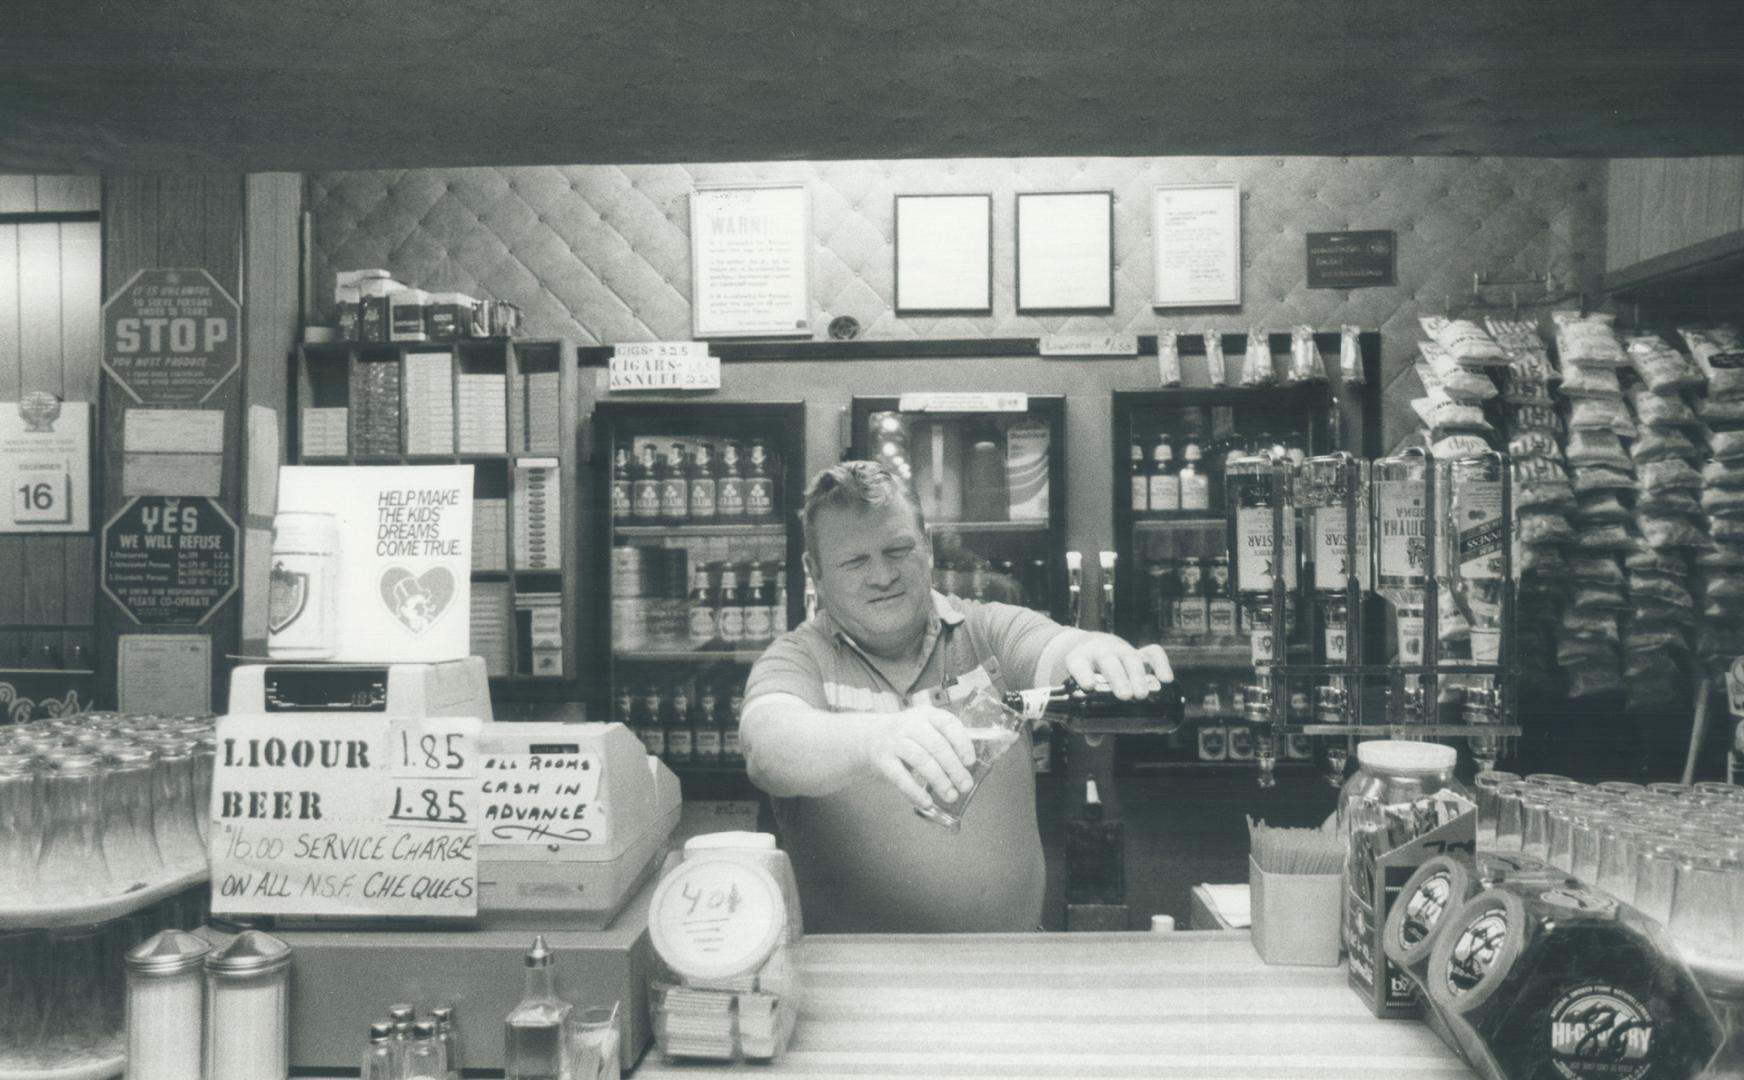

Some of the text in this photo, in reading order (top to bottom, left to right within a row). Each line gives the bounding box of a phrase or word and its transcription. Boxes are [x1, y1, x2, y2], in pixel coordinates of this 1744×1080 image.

[116, 318, 228, 352] STOP
[18, 483, 53, 510] 16
[378, 489, 460, 506] HELP MAKE
[142, 507, 198, 533] YES
[377, 507, 403, 523] THE
[377, 524, 440, 540] DREAMS
[1325, 534, 1348, 546] STAR
[120, 534, 221, 549] WE WILL REFUSE
[376, 540, 463, 556] COME TRUE.
[1248, 535, 1273, 547] STAR
[128, 596, 156, 606] PLEASE
[223, 730, 465, 769] LIQOUR 1.85
[529, 756, 590, 771] ROOMS
[481, 781, 581, 795] CASH IN
[221, 787, 467, 822] BEER 1.85
[485, 803, 587, 820] ADVANCE
[294, 833, 387, 860] SERVICE
[391, 831, 476, 861] CHARGE
[221, 873, 251, 897] ON
[253, 871, 291, 897] ALL
[363, 871, 474, 899] CHEQUES
